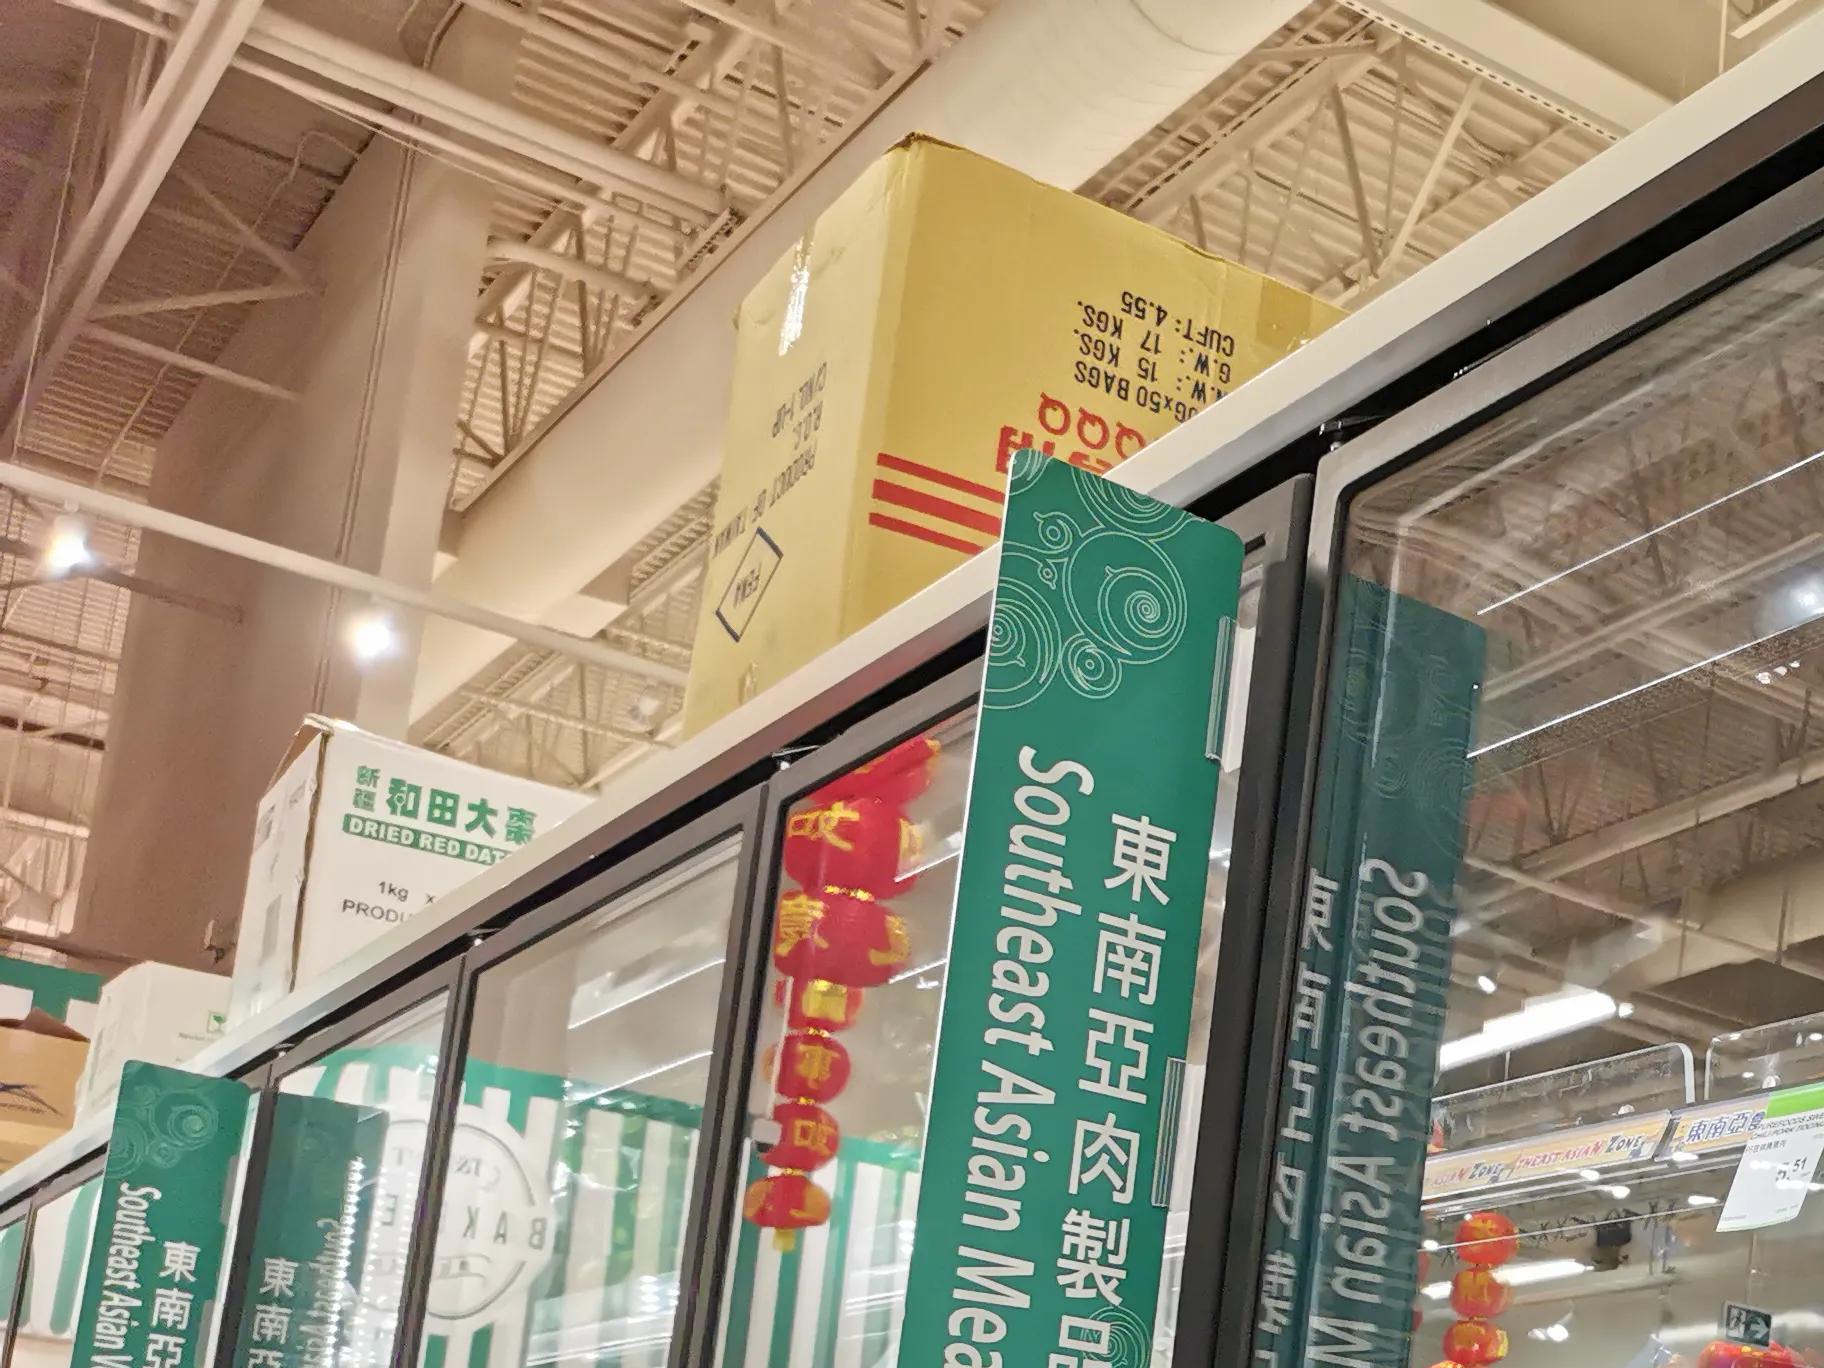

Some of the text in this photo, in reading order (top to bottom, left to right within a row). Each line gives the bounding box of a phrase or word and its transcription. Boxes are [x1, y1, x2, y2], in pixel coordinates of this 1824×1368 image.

[1073, 328, 1121, 368] KGS.
[1077, 300, 1232, 384] G.W.: 17 KGS.
[1120, 291, 1236, 357] CUFT: 4.55
[1074, 360, 1131, 402] BAGS
[1137, 357, 1158, 383] 15
[349, 816, 415, 846] DRIED
[419, 834, 461, 857] RED
[378, 880, 410, 903] 1kg
[979, 744, 1097, 1056] Southeast
[959, 1056, 1057, 1232] Asian
[1562, 1139, 1602, 1165] ASIAN
[1605, 1132, 1642, 1155] ZONE
[98, 1183, 163, 1302] Southeast
[88, 1300, 144, 1357] Asian
